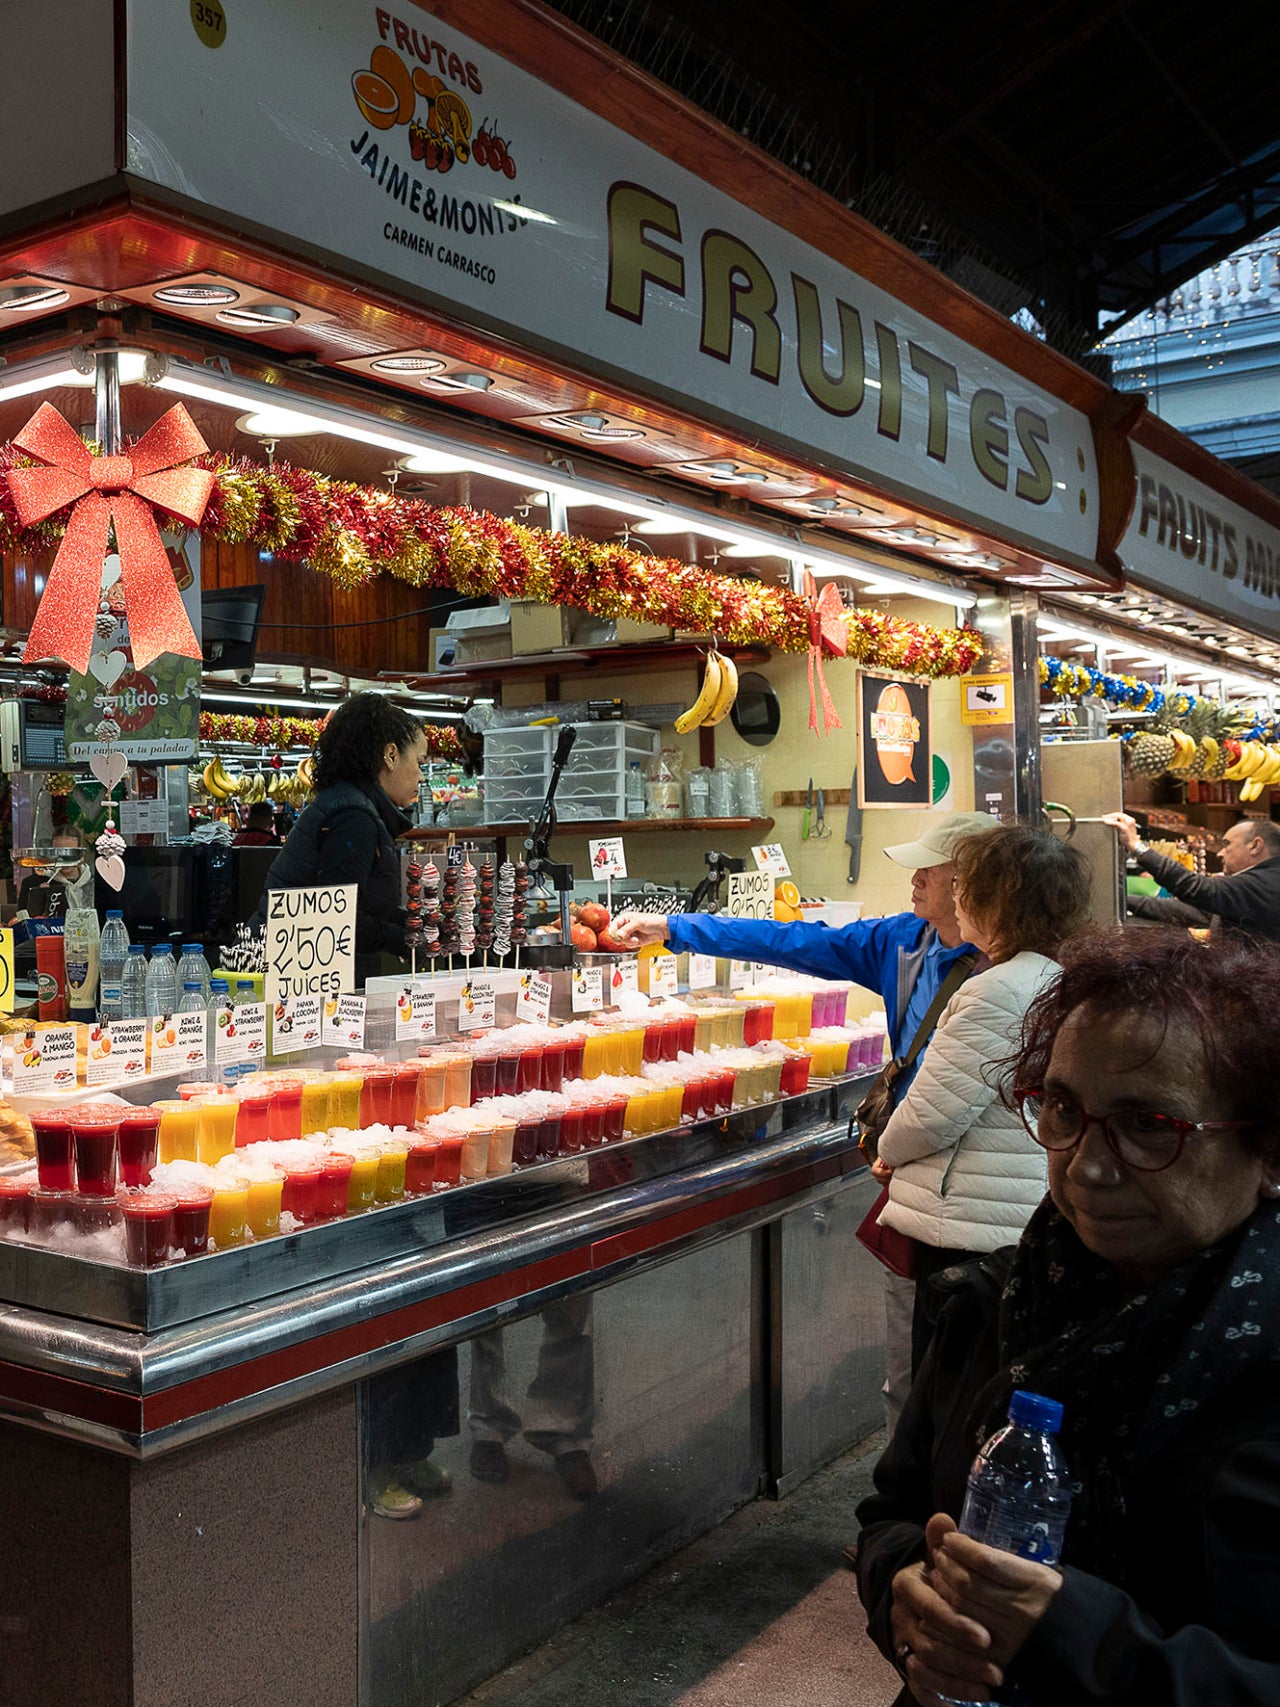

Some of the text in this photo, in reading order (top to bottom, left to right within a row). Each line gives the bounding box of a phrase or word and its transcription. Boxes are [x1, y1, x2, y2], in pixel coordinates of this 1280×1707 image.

[195, 1, 222, 31] 357
[375, 7, 483, 95] FRUTAS
[384, 223, 496, 285] CARMEN CARRASCO
[605, 180, 1053, 506] FRUITES
[1139, 473, 1238, 580] FRUITS
[73, 746, 90, 755] Del
[137, 745, 147, 753] tu
[150, 743, 189, 755] paladar
[731, 872, 770, 896] ZUMOS
[270, 888, 347, 920] ZUMOS
[272, 923, 352, 975] 2'50€
[296, 999, 314, 1009] PAPAYA
[340, 999, 359, 1007] BANANA
[296, 1006, 320, 1018] COCONUT
[180, 1016, 195, 1026] KIWI
[235, 1014, 265, 1026] STRAWBERRY
[111, 1024, 145, 1034] STRAWBERRY
[178, 1025, 203, 1035] ORANGE
[44, 1032, 73, 1043] ORANGE
[118, 1034, 142, 1043] ORANGE
[41, 1040, 75, 1054] & MANGO
